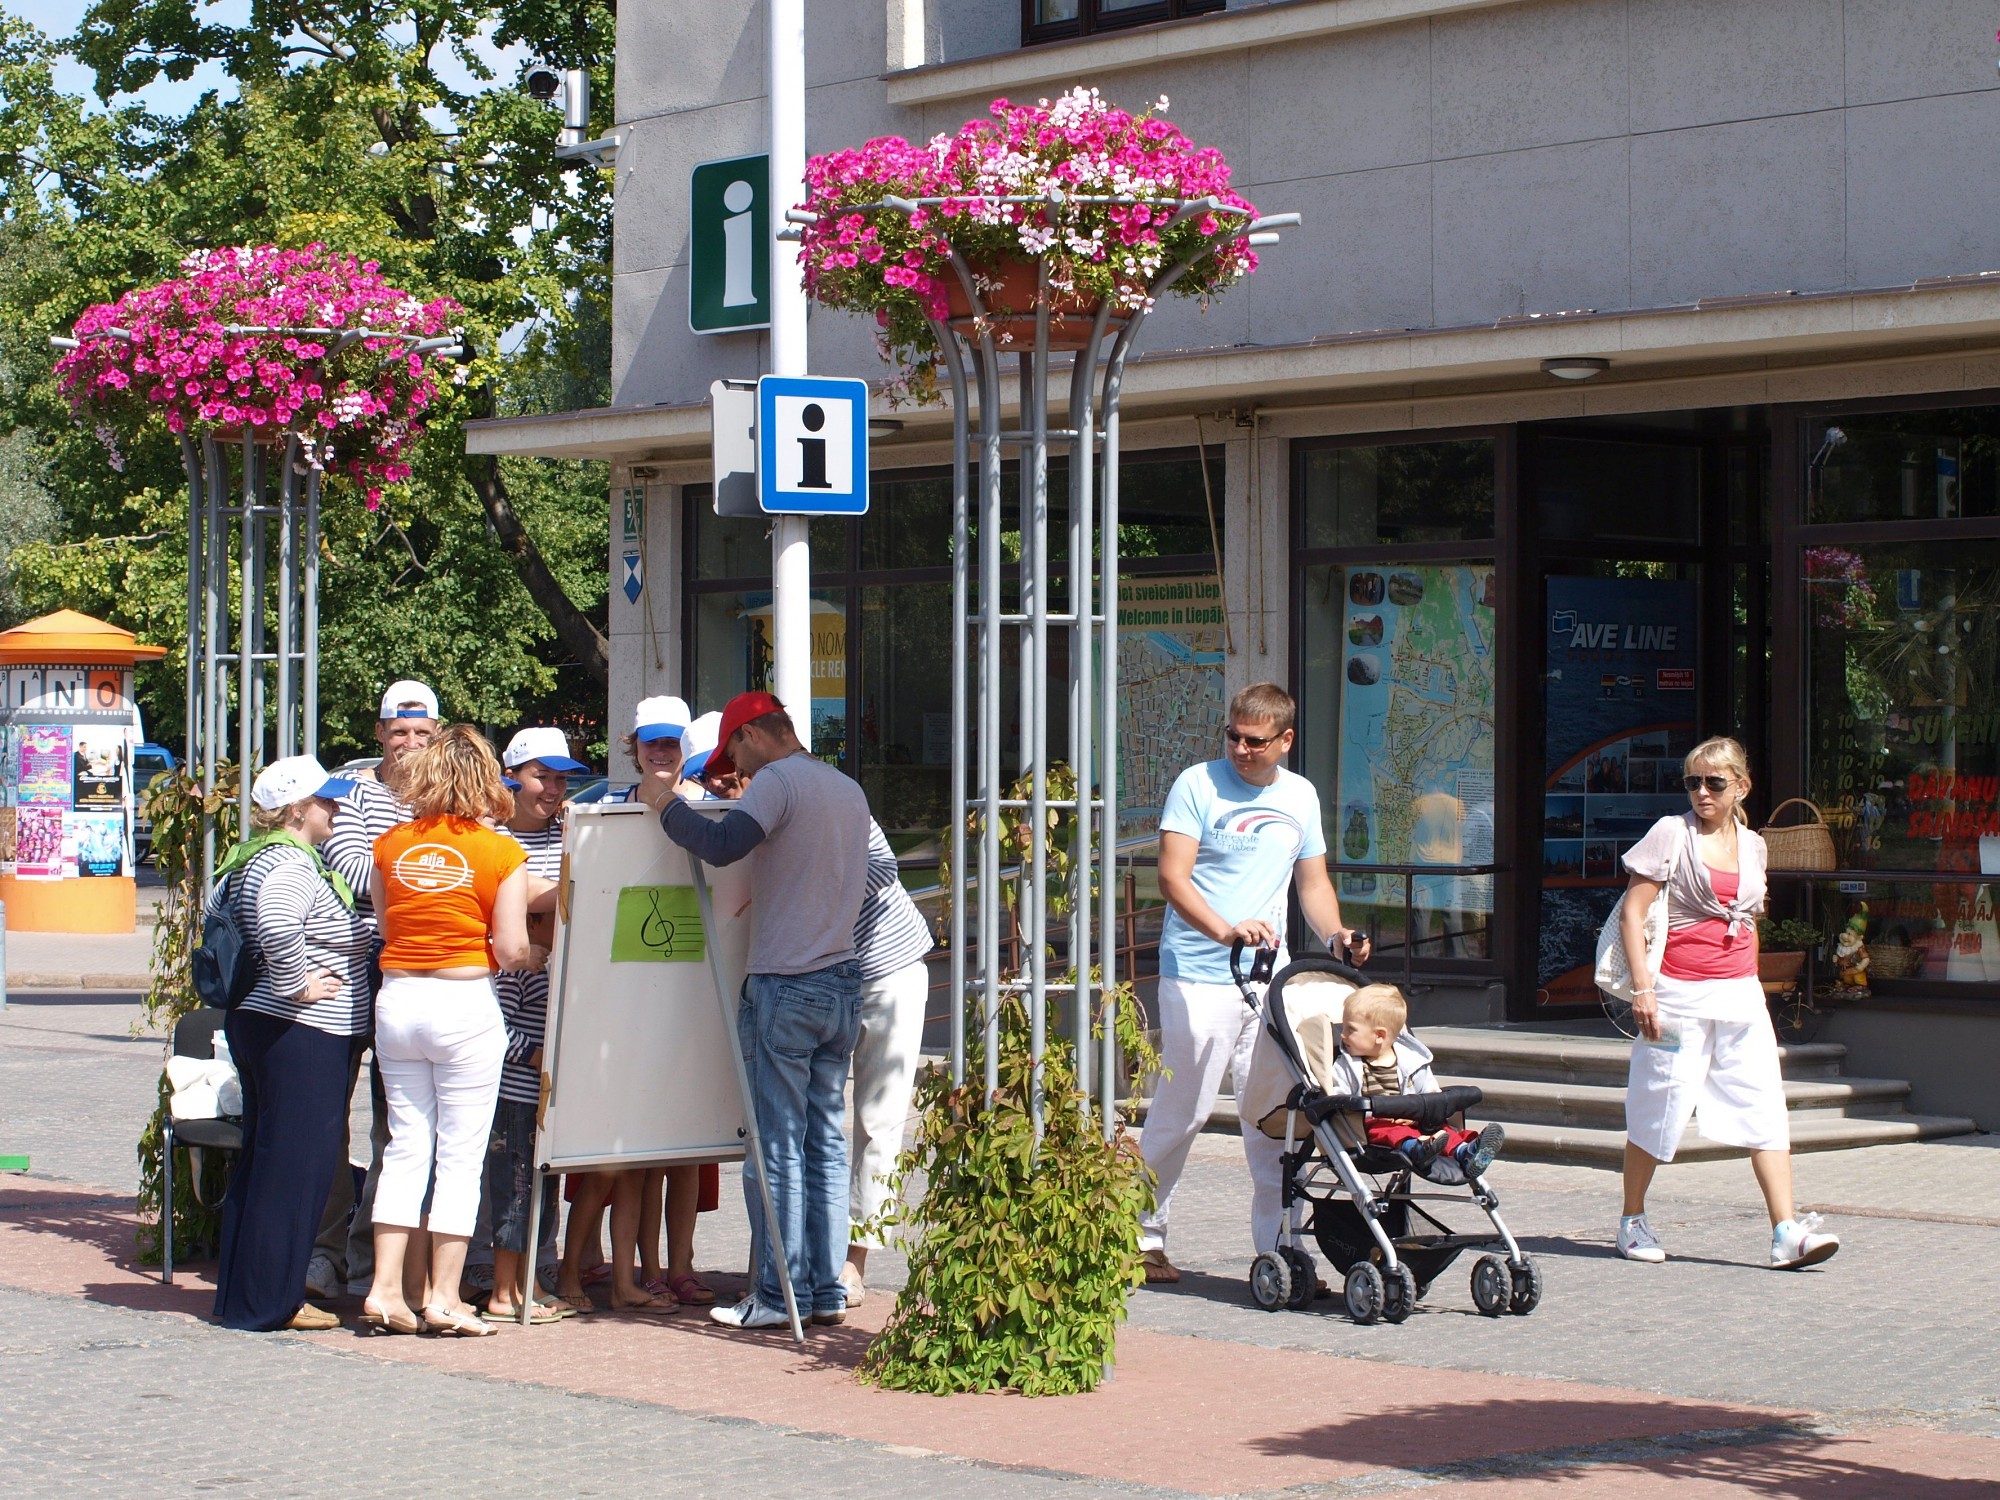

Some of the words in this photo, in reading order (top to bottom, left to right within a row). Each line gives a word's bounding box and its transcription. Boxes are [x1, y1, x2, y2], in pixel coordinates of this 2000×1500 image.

[1136, 582, 1192, 601] sveicināti
[1195, 581, 1221, 600] Liep
[1118, 608, 1168, 625] Welcome
[1172, 607, 1183, 624] in
[1569, 623, 1619, 649] AVE
[1623, 624, 1678, 651] LINE
[1838, 754, 1854, 770] 10
[1869, 754, 1885, 770] 19
[1838, 774, 1854, 790] 10
